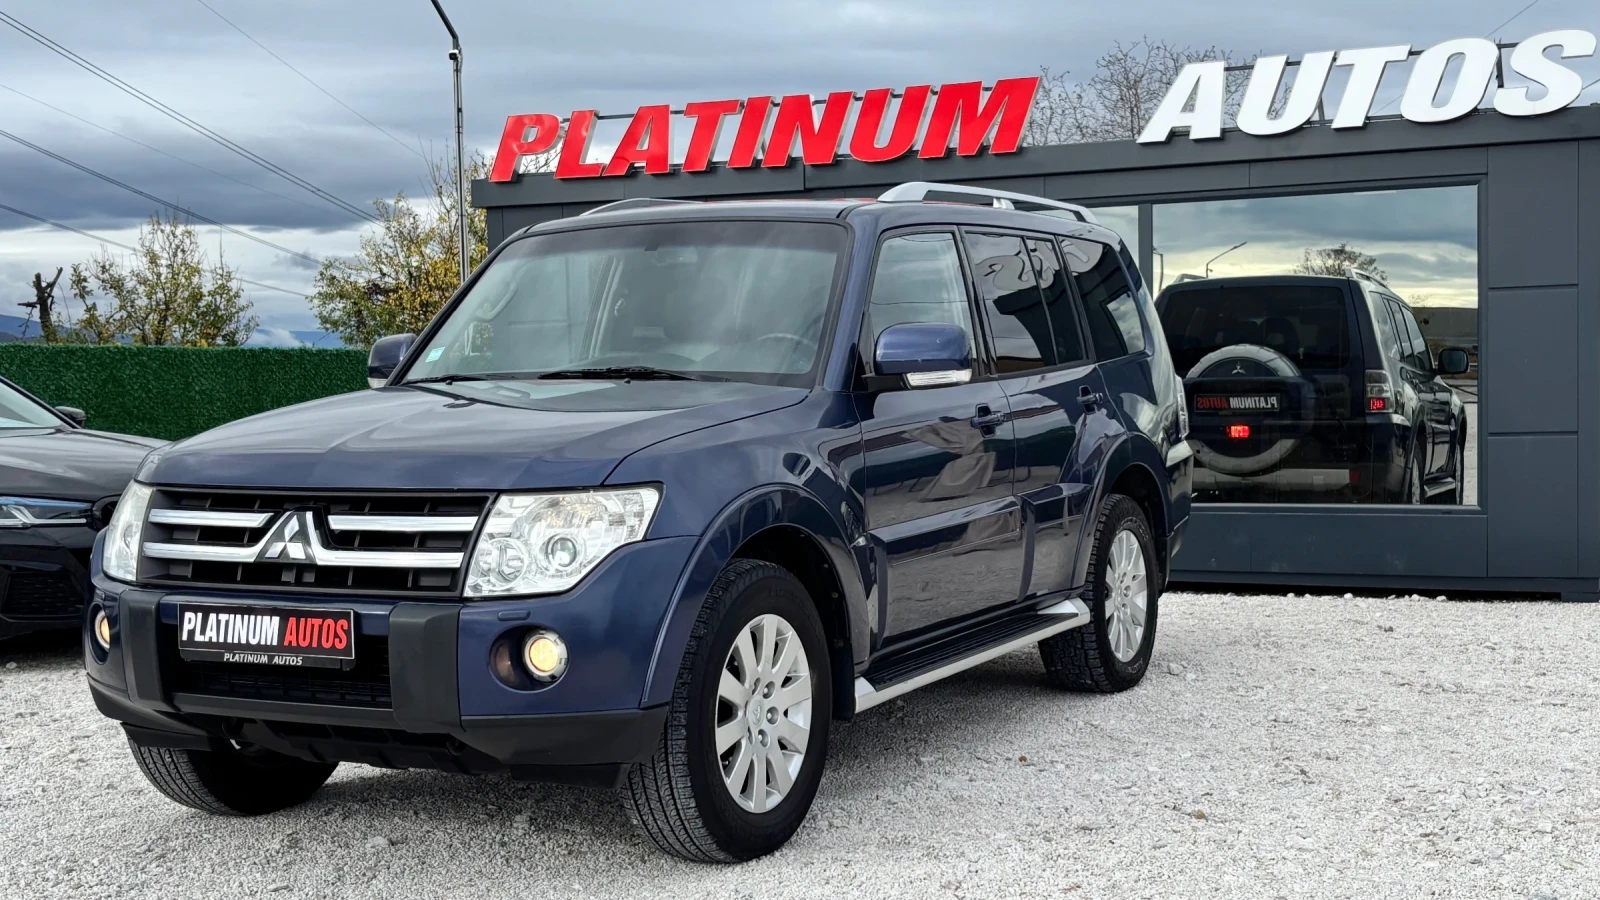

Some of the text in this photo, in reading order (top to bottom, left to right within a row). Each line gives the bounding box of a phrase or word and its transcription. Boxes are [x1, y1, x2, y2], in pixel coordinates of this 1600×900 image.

[490, 29, 1597, 182] PLATINUM AUTOS
[182, 611, 348, 649] PLATINUM AUTOS
[223, 652, 303, 666] PLATINUM AUTOS
